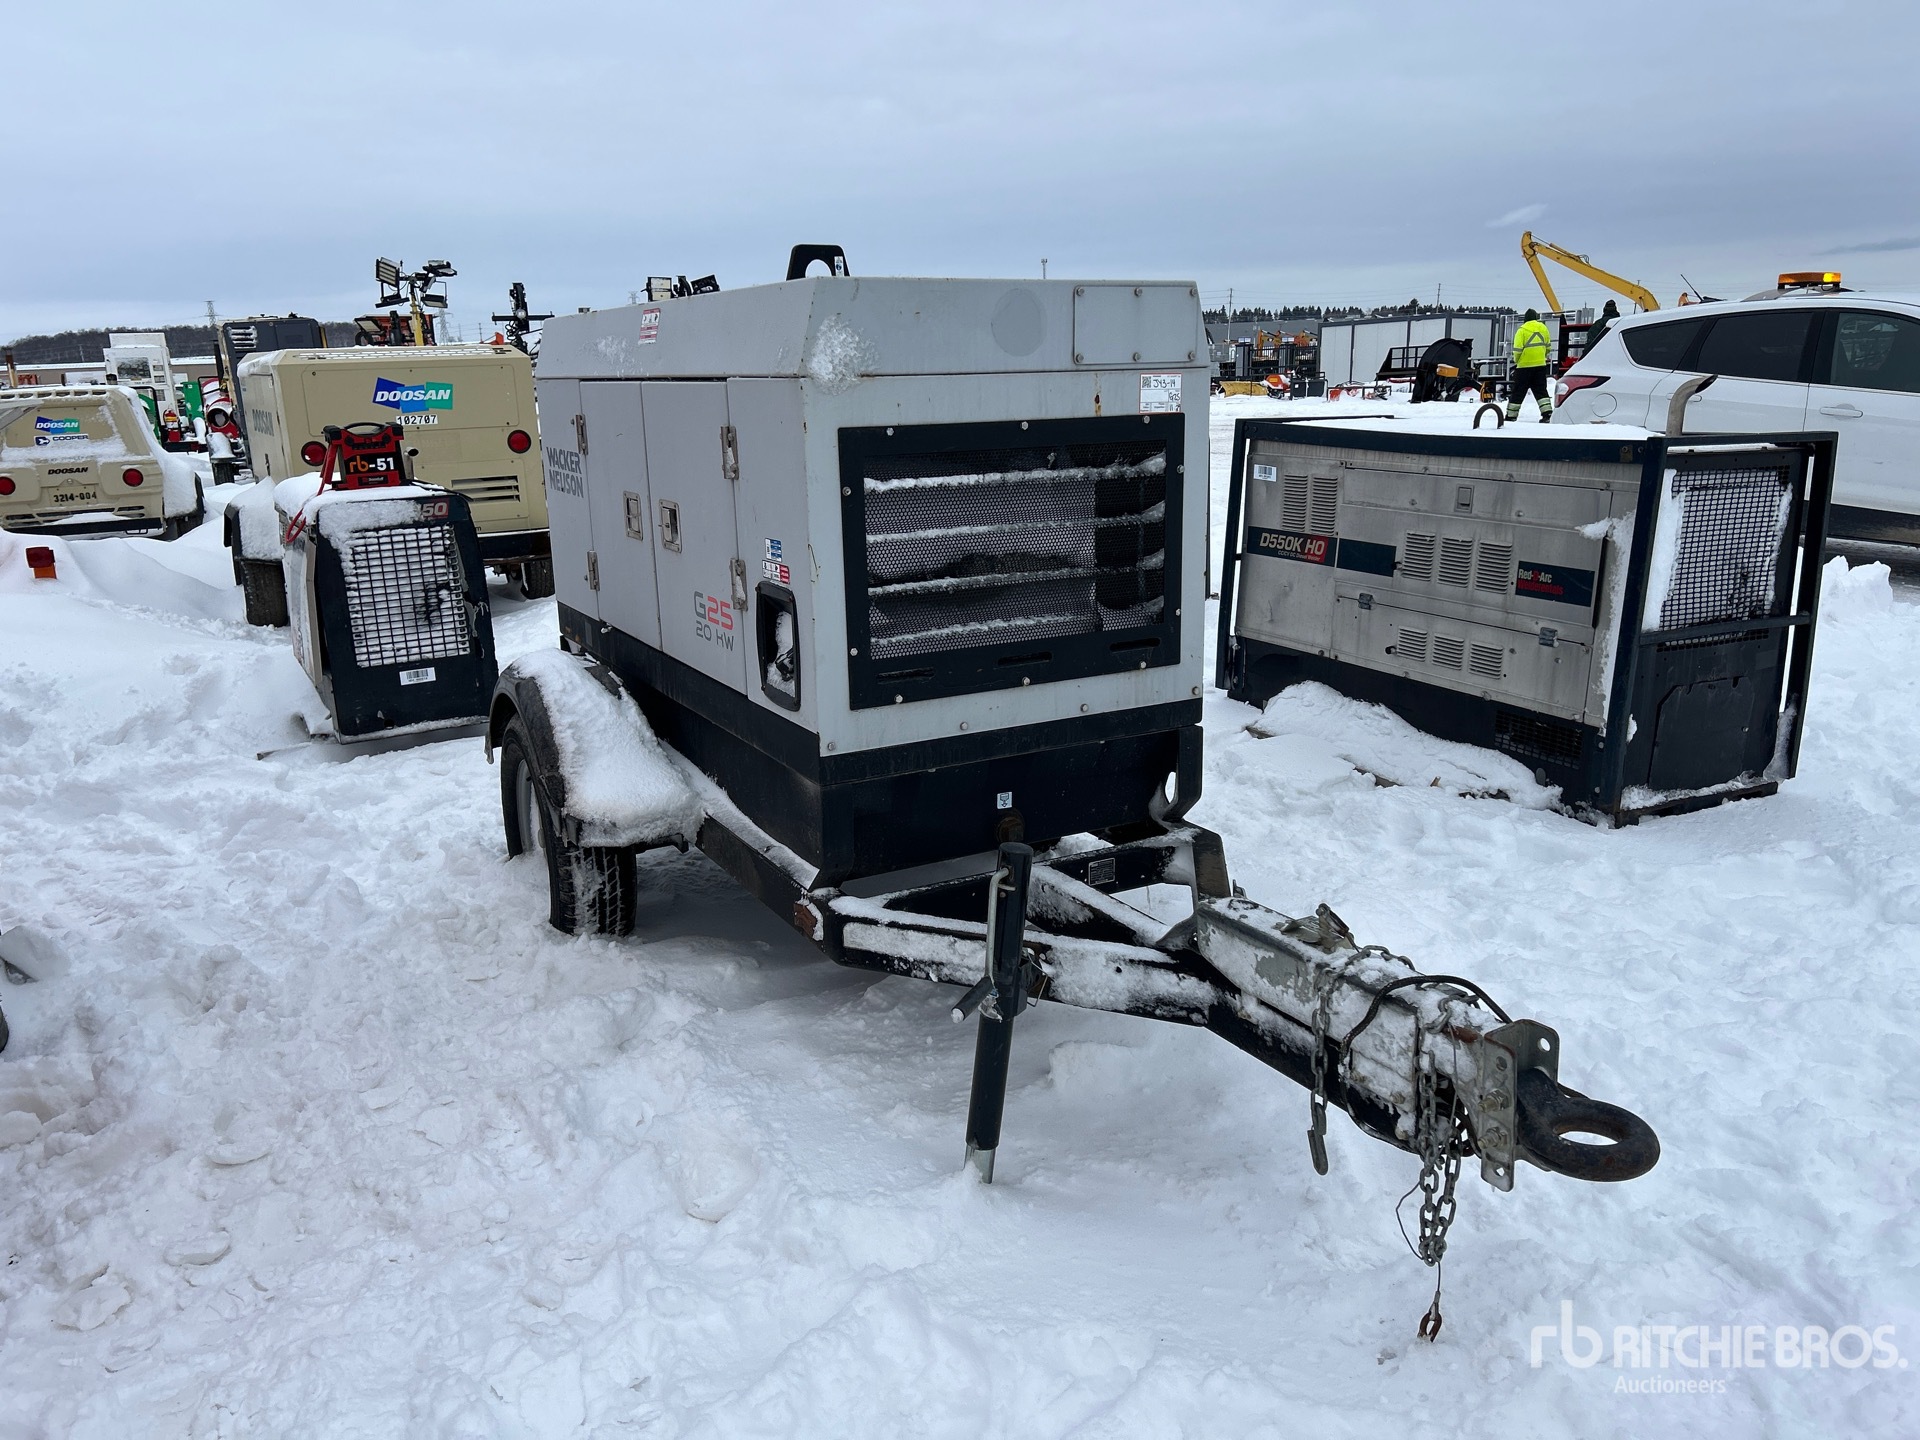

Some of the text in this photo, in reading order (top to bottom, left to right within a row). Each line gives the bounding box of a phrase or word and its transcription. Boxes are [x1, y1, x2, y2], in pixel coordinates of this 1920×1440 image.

[375, 389, 451, 402] DOOSAN
[36, 421, 79, 429] DOOSAN
[252, 409, 275, 437] DOOSAN
[397, 414, 437, 425] 102707
[52, 434, 89, 442] COOPER
[349, 455, 395, 473] rb-51
[546, 446, 582, 475] WACKER
[47, 466, 89, 476] DOOSAN
[549, 469, 584, 499] NEUSON
[53, 491, 97, 503] 3214-004
[1260, 533, 1325, 555] D550K HO
[1518, 569, 1552, 583] Red-D-Arc
[694, 590, 734, 631] G25
[696, 619, 712, 642] 20
